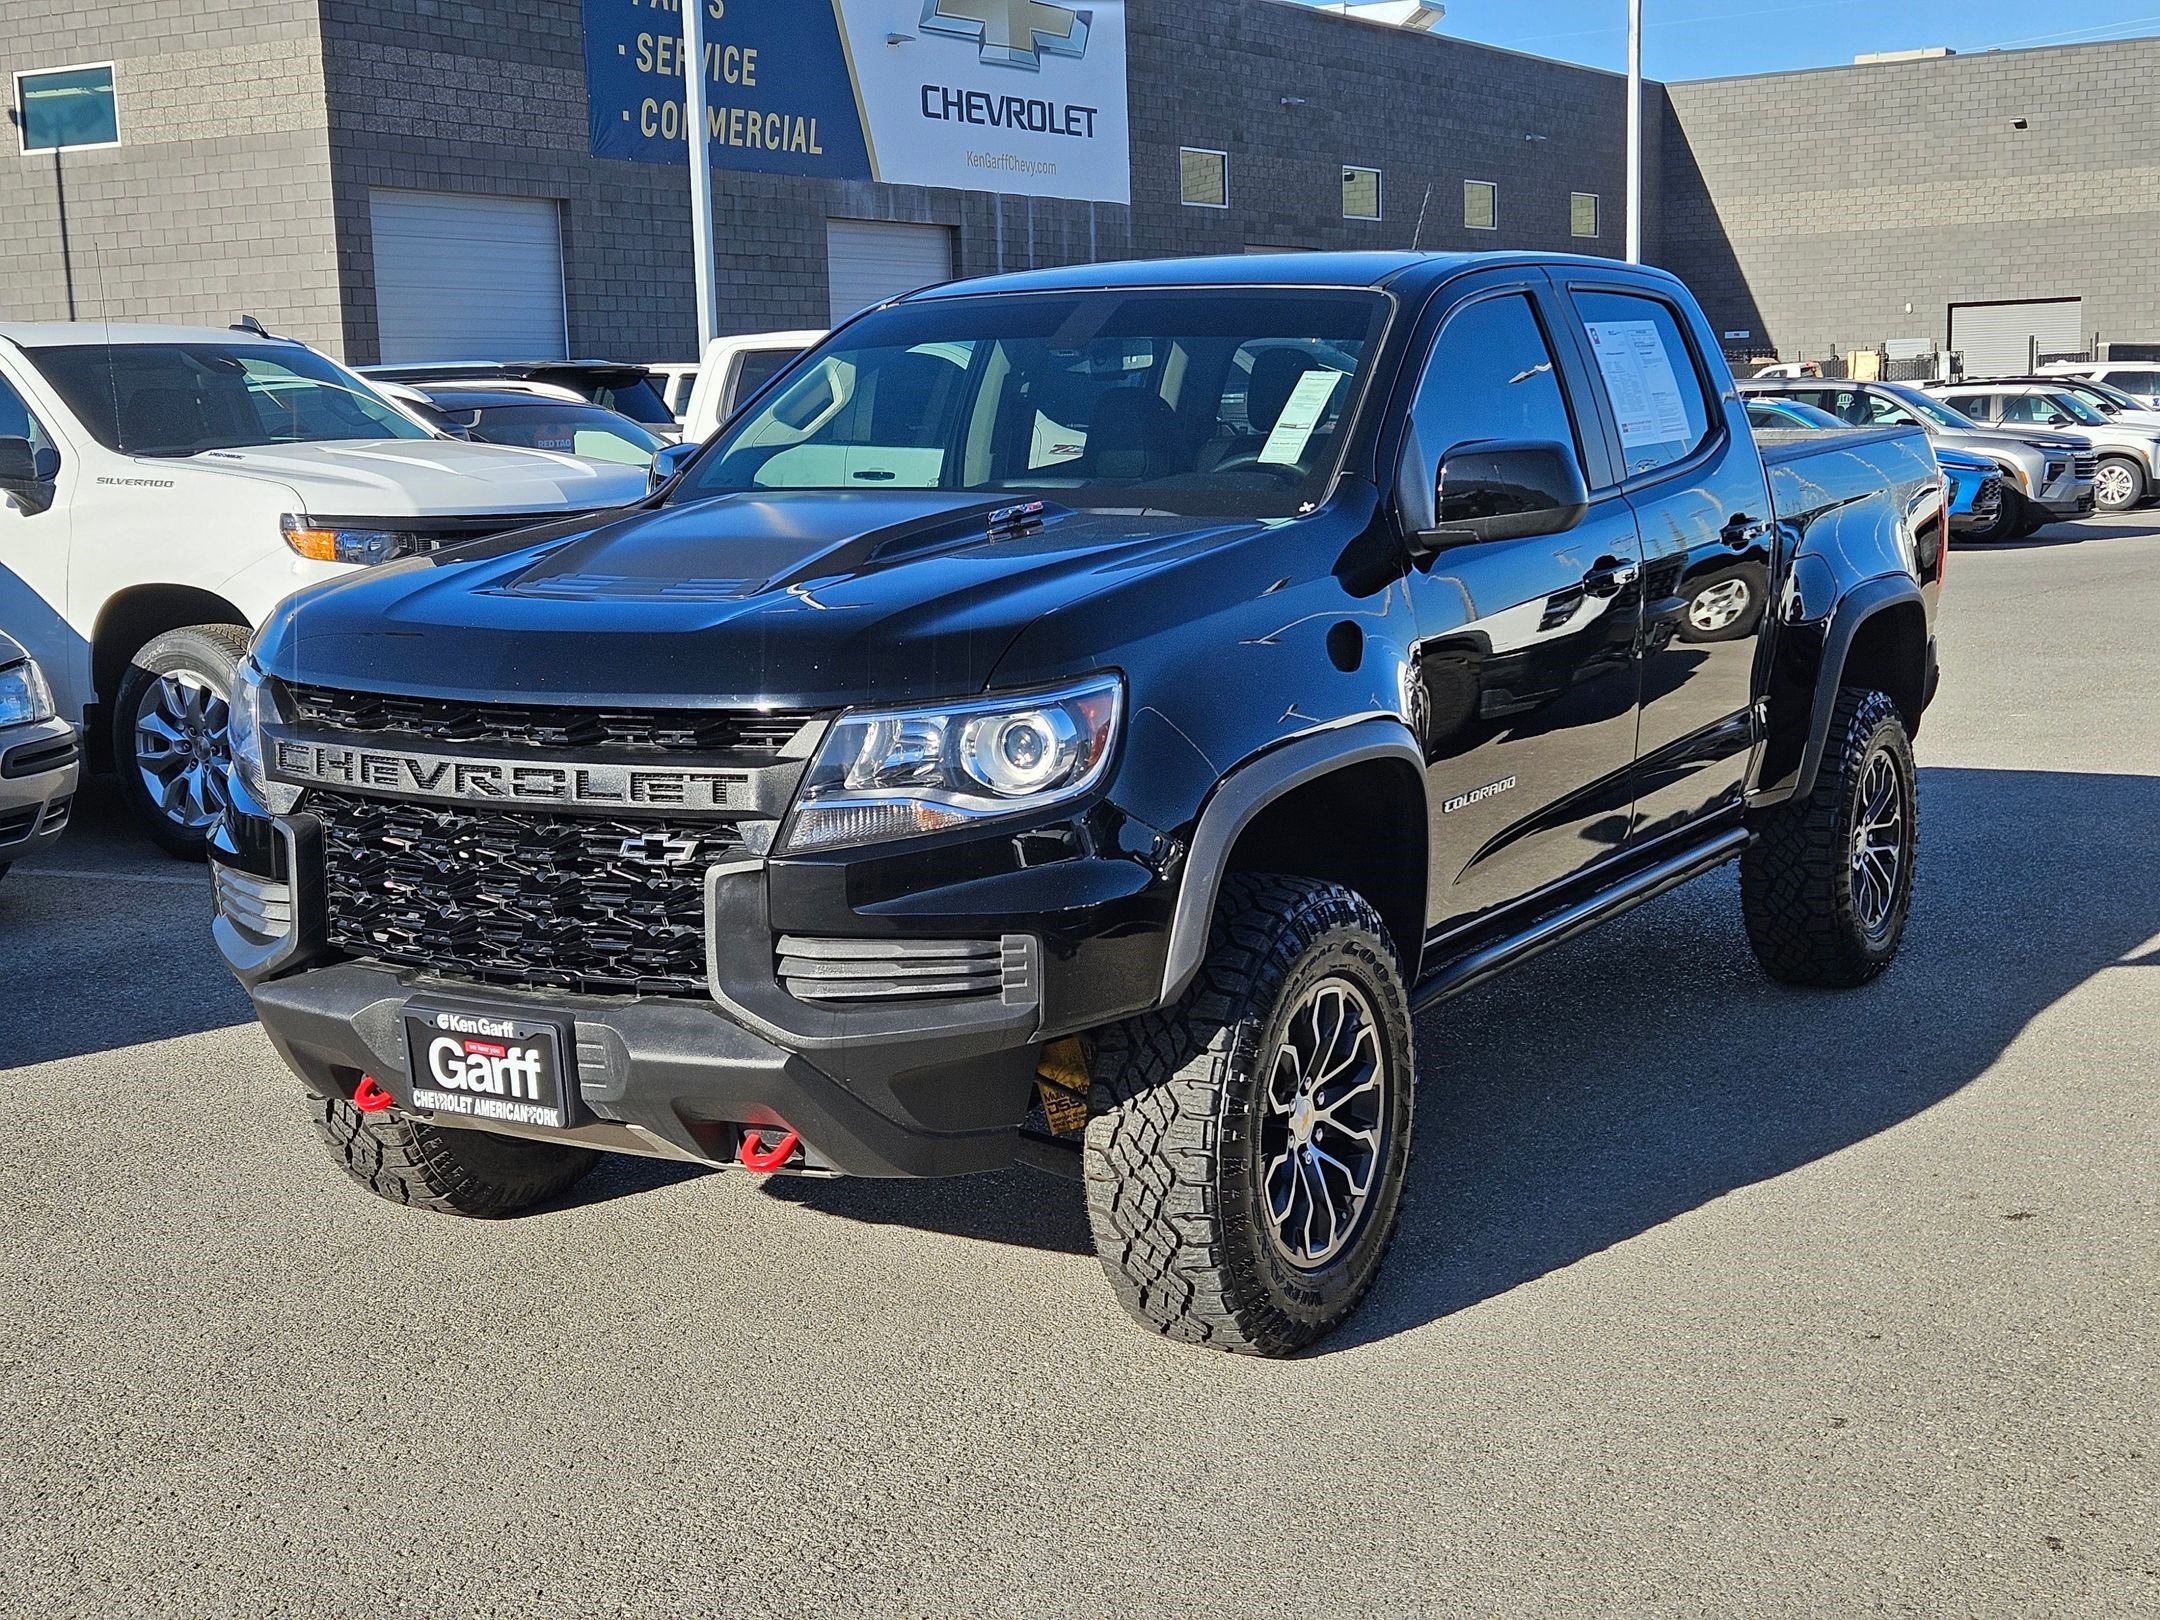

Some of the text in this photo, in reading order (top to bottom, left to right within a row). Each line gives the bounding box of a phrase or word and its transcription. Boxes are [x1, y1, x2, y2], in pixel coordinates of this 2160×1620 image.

[921, 84, 1098, 138] CHEVROLET
[966, 151, 1057, 177] KenGarffChevy.com
[96, 477, 174, 488] SILVERADO
[278, 741, 748, 804] CHEVROLET
[1443, 775, 1516, 813] COLORADO
[429, 1036, 542, 1100] Garff
[413, 1089, 473, 1114] CHEVROLET
[473, 1097, 529, 1123] AMERICAN
